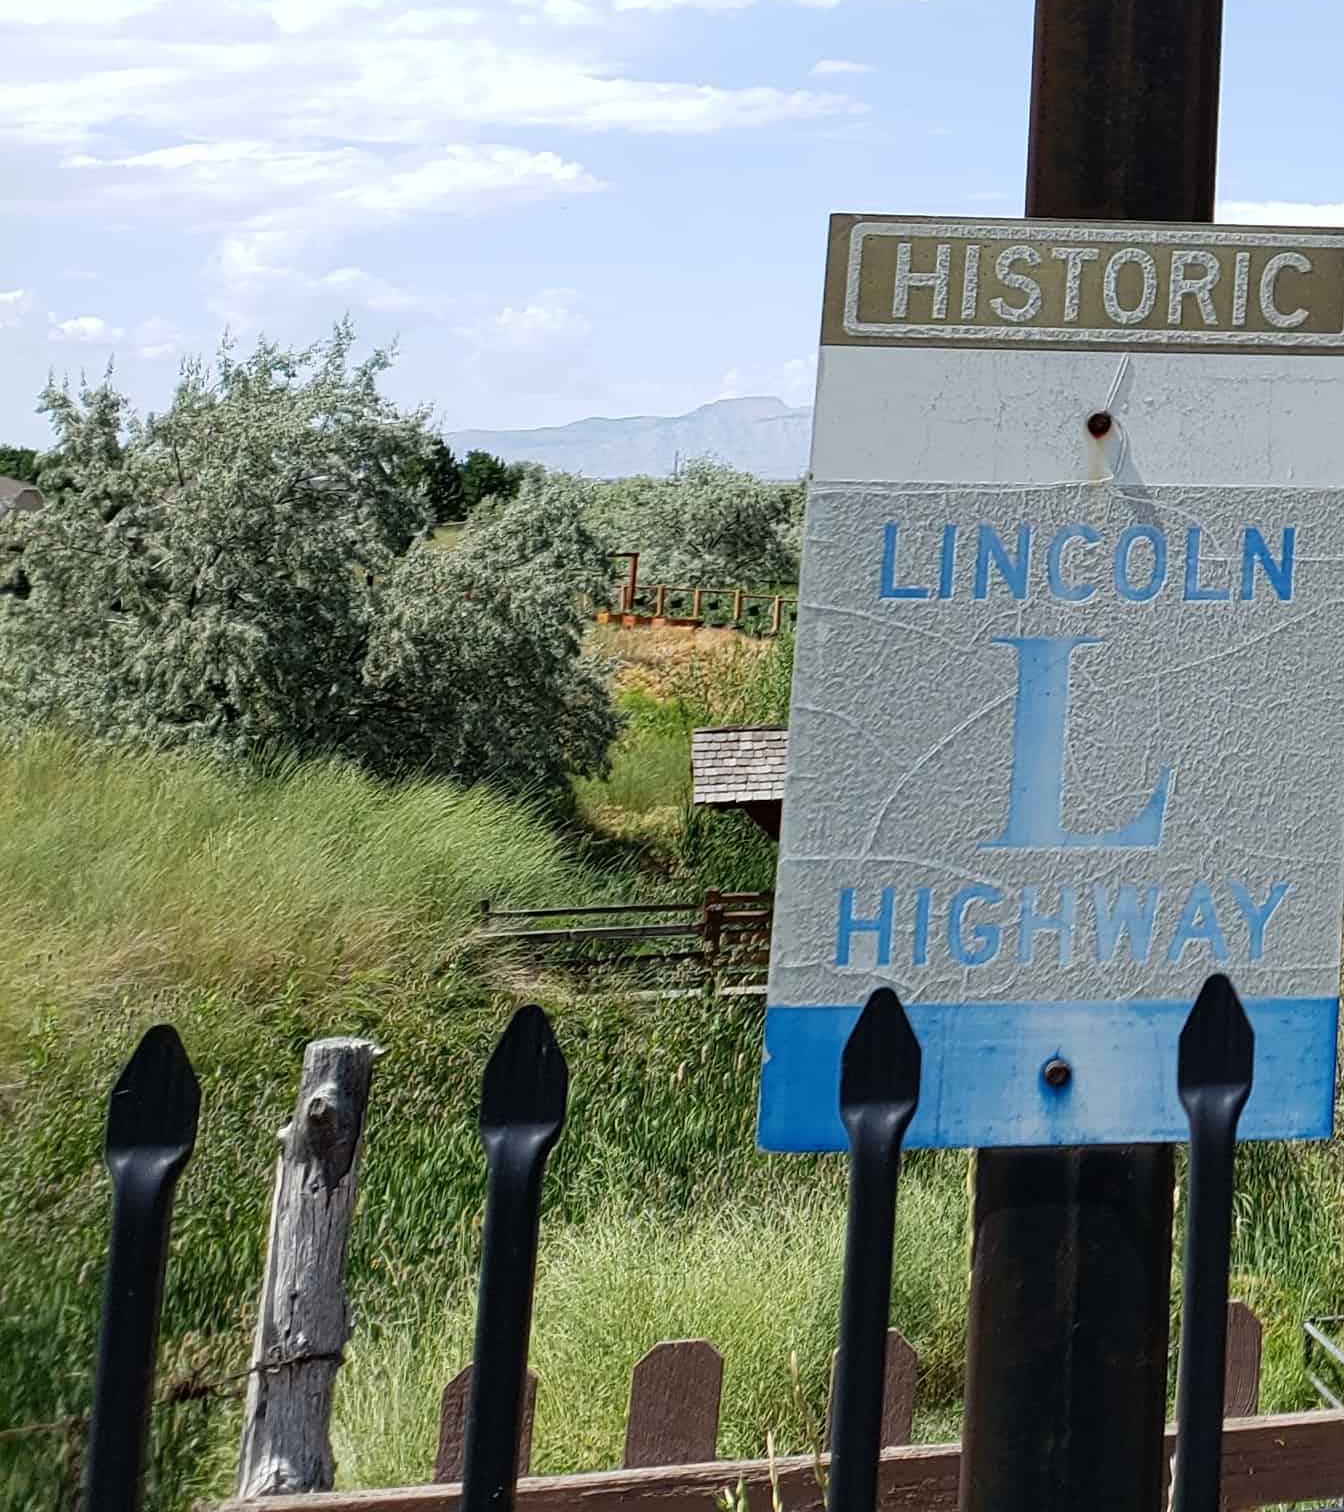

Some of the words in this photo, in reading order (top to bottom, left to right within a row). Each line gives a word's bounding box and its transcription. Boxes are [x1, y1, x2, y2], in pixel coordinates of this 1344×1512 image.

[892, 242, 1314, 330] HISTORIC
[878, 521, 1297, 604] LINCOLN
[976, 636, 1177, 850] L
[834, 881, 1292, 968] HIGHWAY
